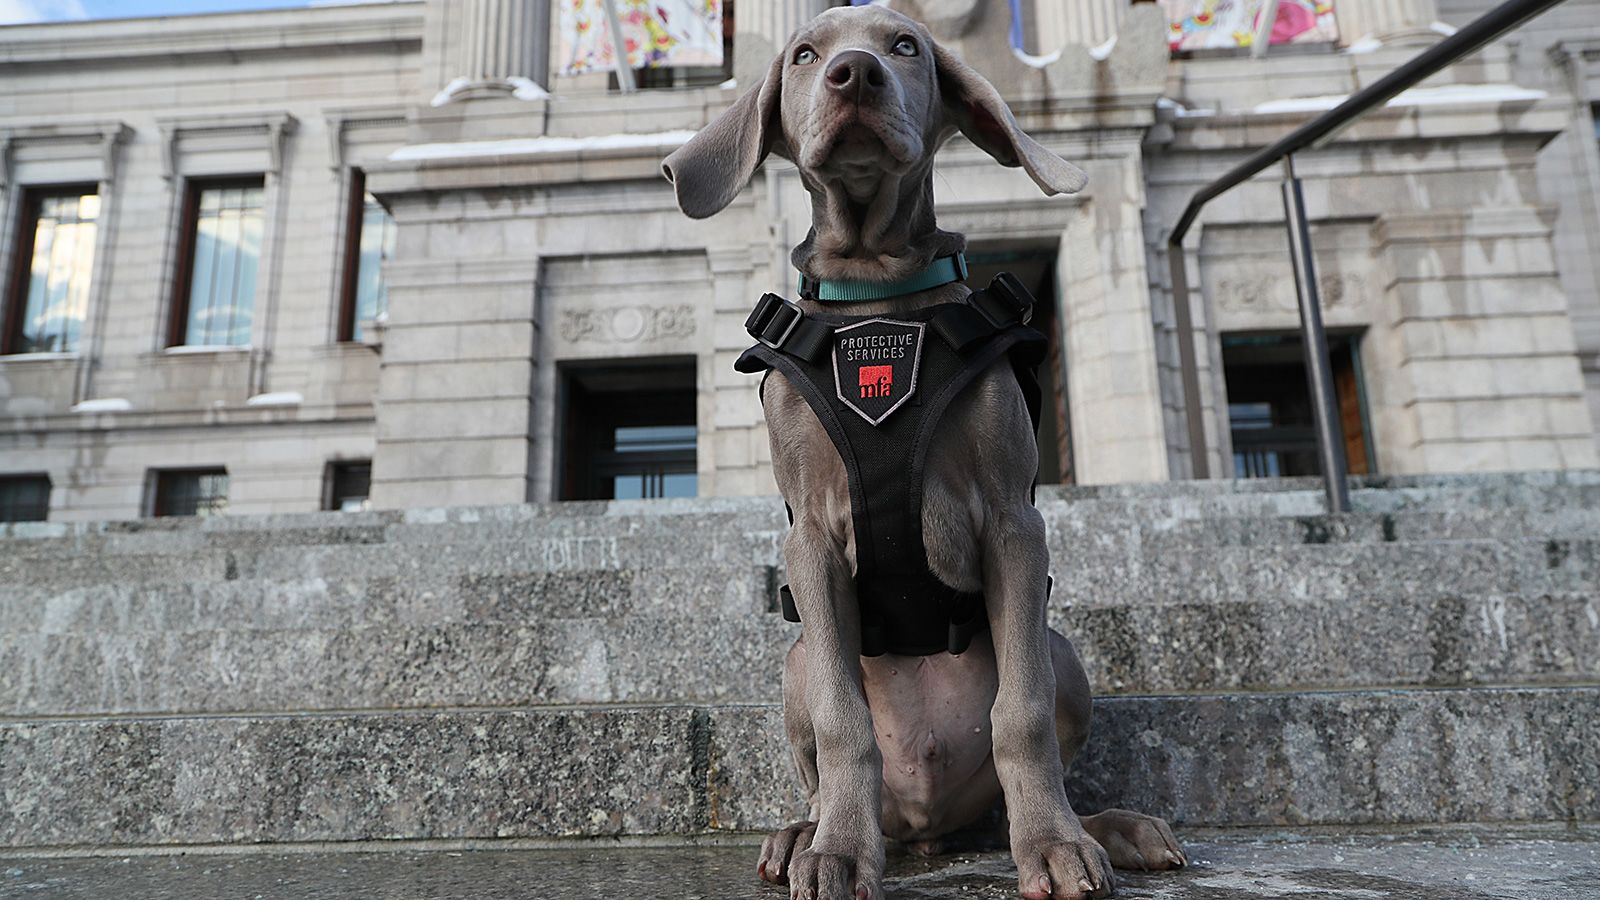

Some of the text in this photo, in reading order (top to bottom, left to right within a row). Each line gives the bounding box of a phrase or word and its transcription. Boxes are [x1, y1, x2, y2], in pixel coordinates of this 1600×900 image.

[841, 333, 913, 350] PROTECTIVE
[847, 347, 905, 361] SERVICES
[859, 375, 892, 398] mfa
